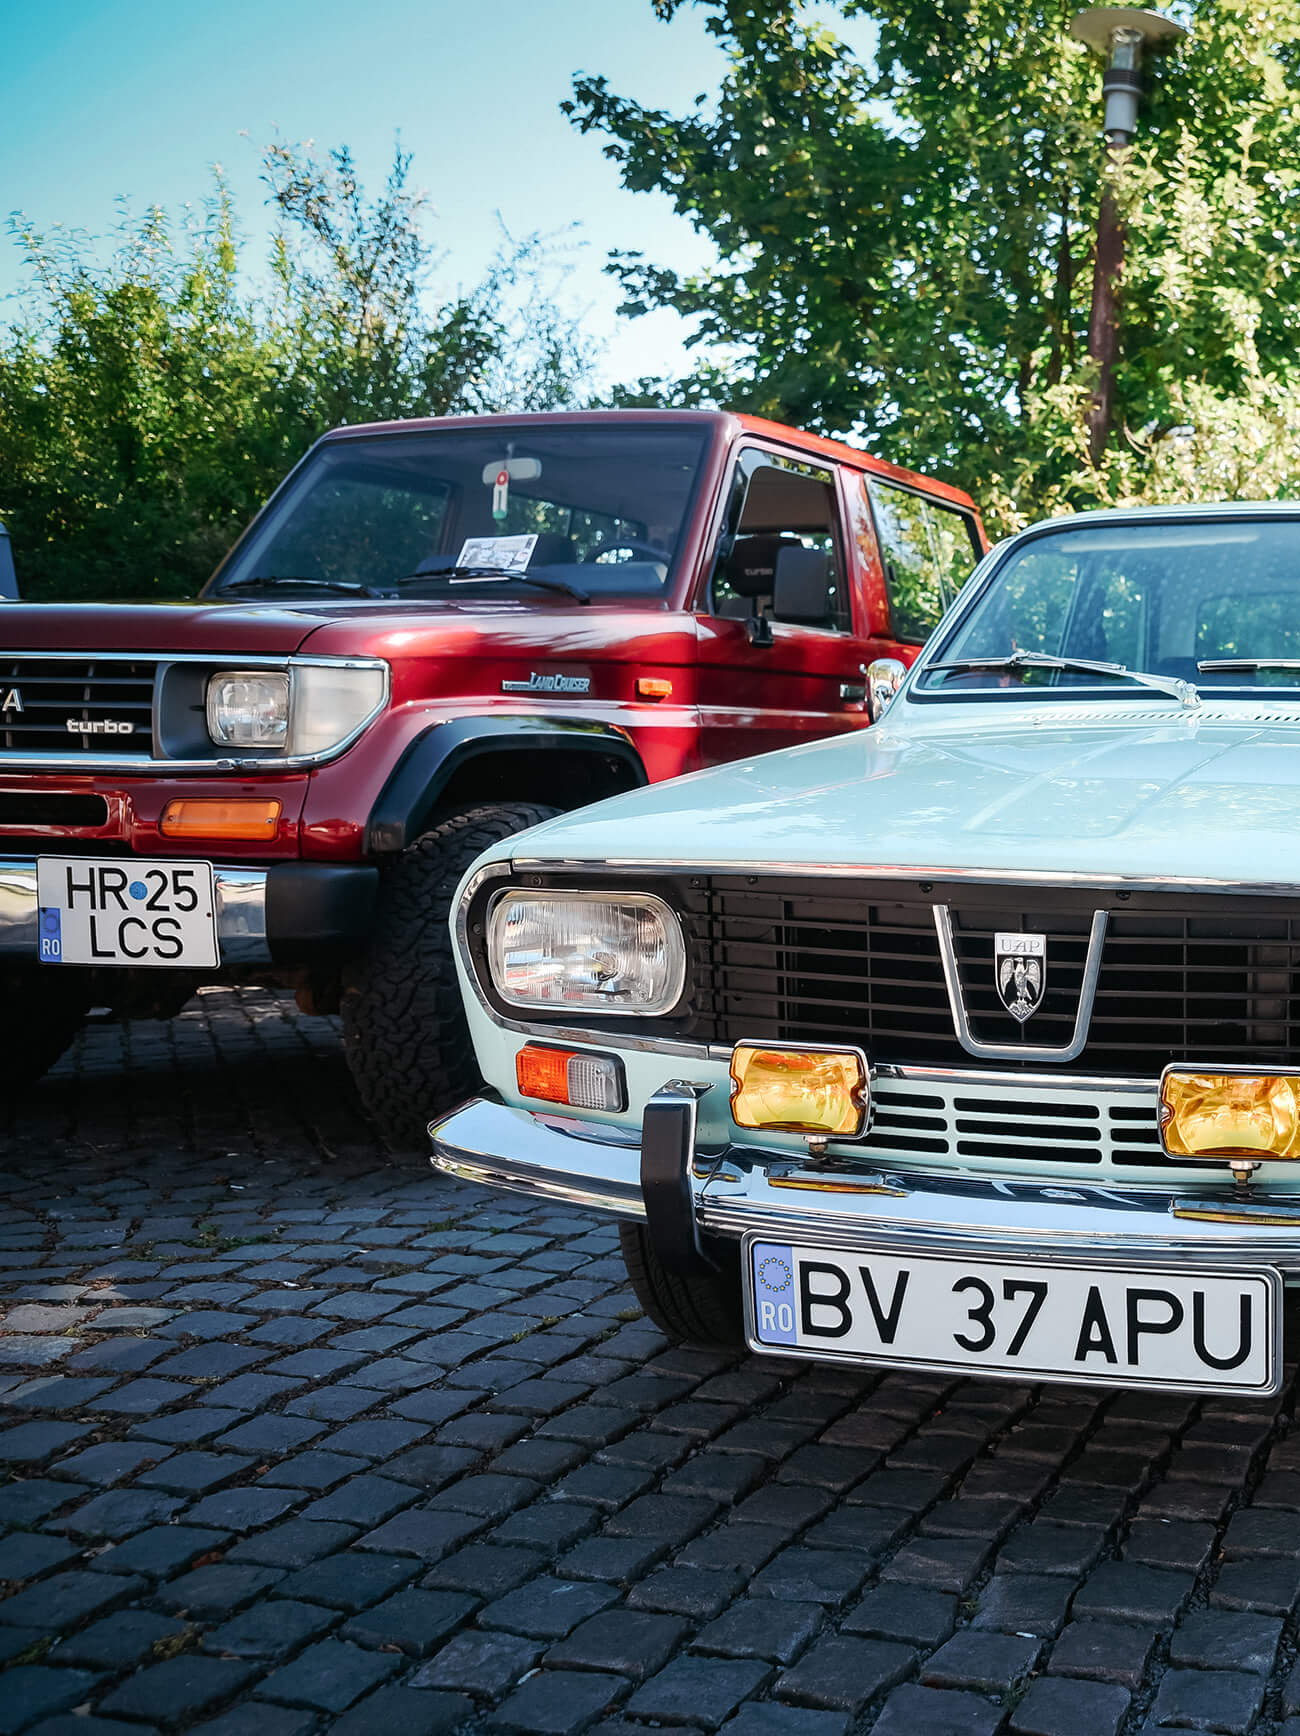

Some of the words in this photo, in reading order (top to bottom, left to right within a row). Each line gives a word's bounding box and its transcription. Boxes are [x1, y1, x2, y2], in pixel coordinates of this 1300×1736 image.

[0, 687, 24, 713] A
[66, 718, 134, 734] turbo
[66, 866, 130, 911] HR
[145, 869, 199, 912] 25
[42, 938, 60, 956] RO
[90, 915, 184, 959] LCS
[1001, 938, 1040, 953] UAP
[760, 1300, 794, 1332] RO
[798, 1260, 911, 1345] BV
[951, 1275, 1049, 1356] 37
[1073, 1285, 1253, 1371] APU
